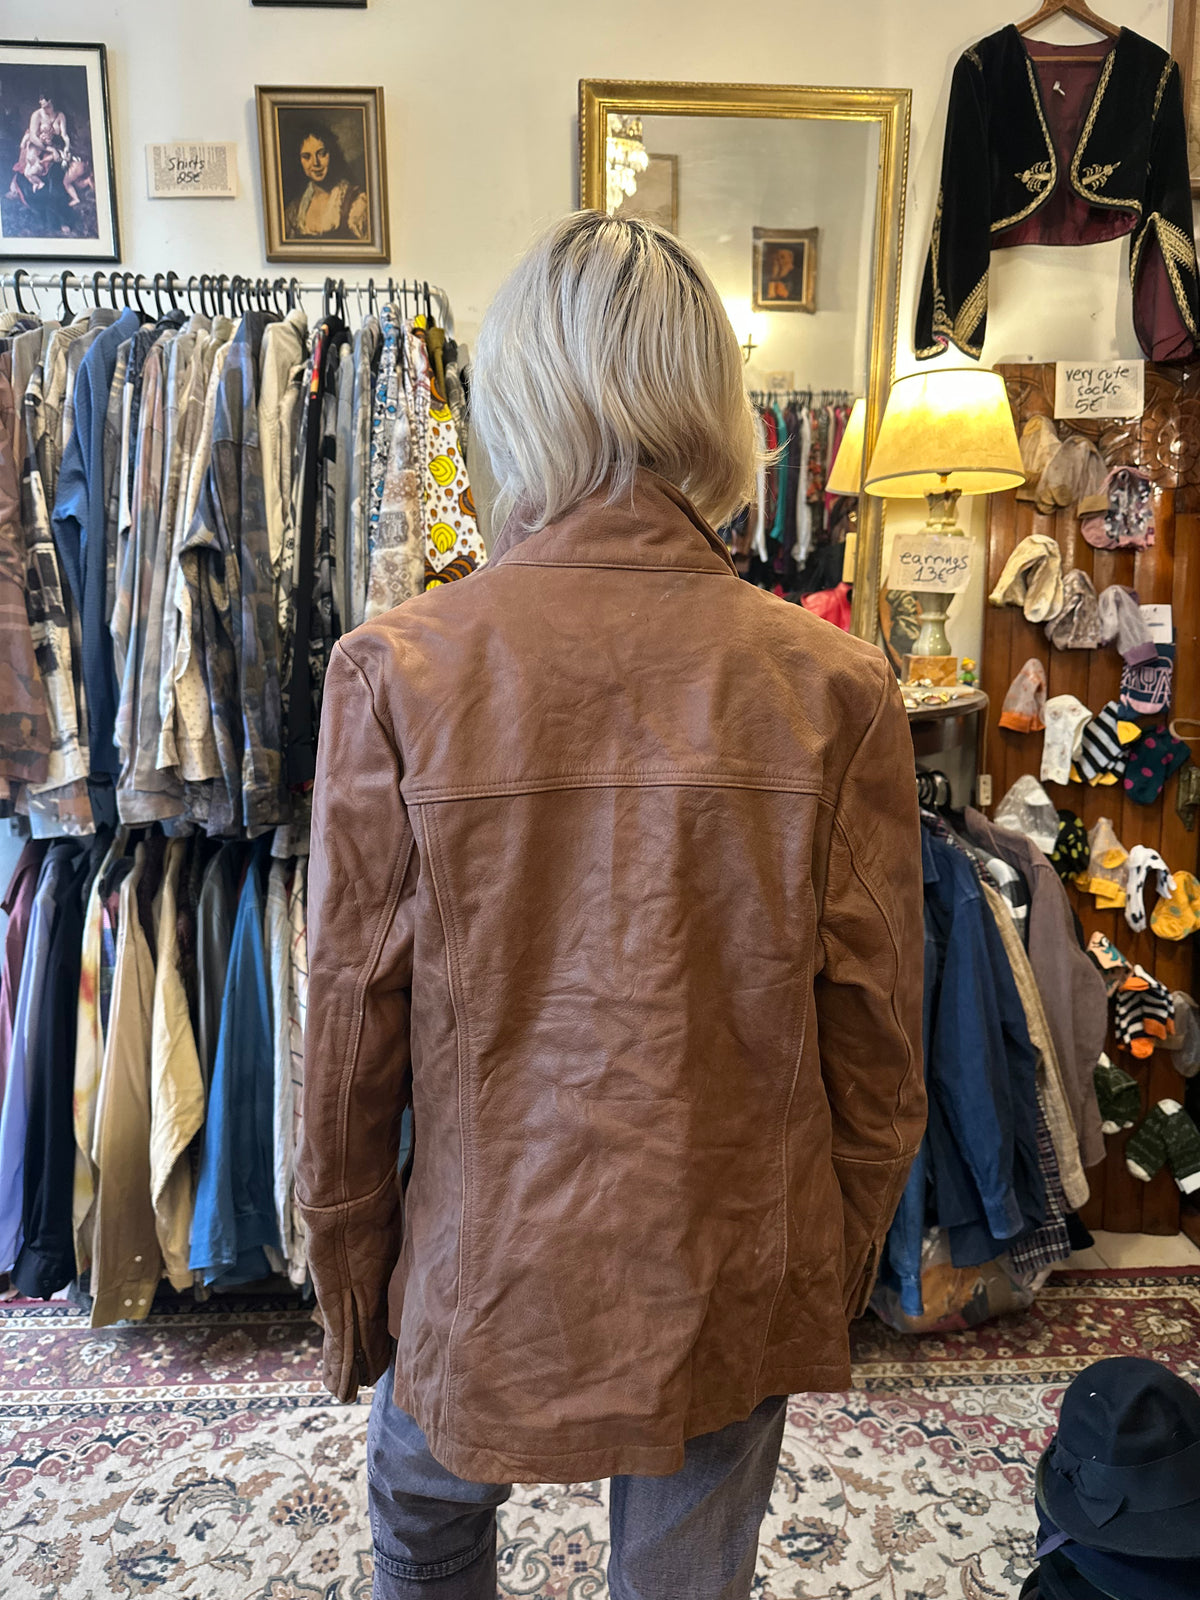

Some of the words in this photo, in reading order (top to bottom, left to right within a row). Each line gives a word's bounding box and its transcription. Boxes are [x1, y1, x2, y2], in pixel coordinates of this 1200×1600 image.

[168, 155, 205, 171] Shirts
[1065, 368, 1093, 386] very
[1097, 365, 1129, 381] cute
[1077, 379, 1121, 396] socks
[1074, 396, 1105, 414] 5€
[912, 566, 947, 583] 13€
